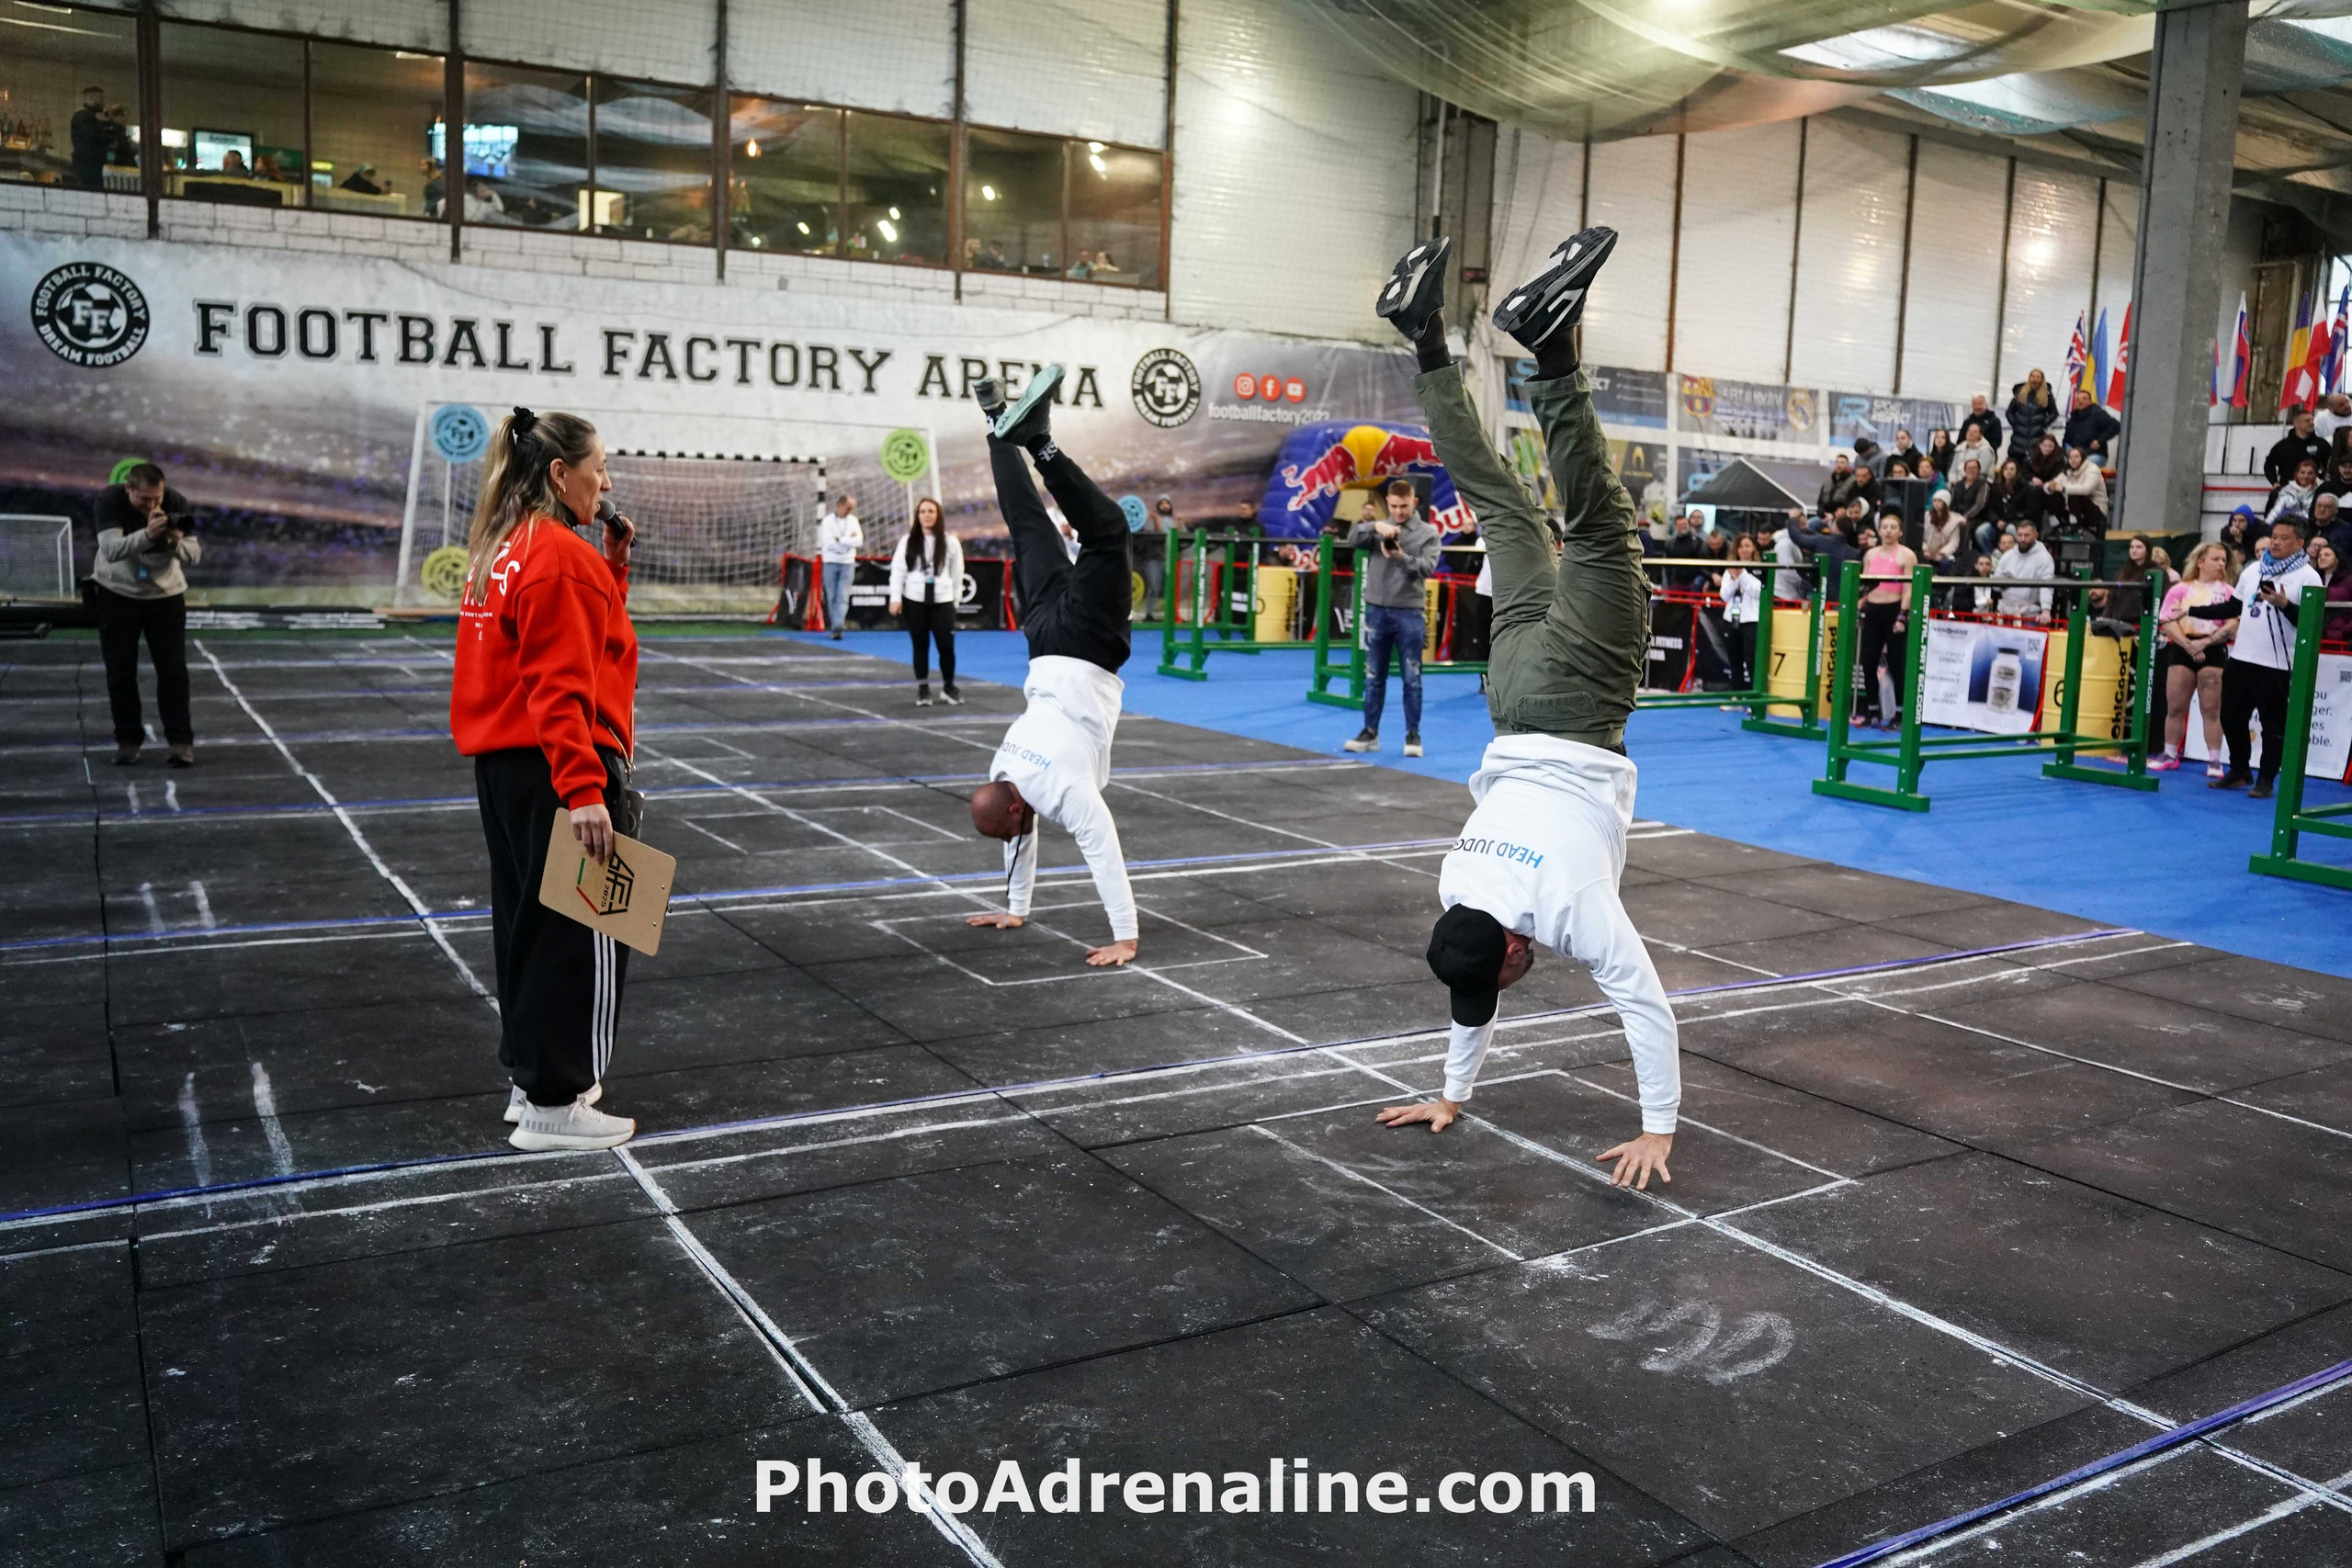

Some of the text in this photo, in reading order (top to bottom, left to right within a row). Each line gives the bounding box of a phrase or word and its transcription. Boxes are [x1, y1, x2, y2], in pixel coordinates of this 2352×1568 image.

[193, 299, 576, 375] FOOTBALL
[601, 328, 892, 395] FACTORY
[1774, 651, 1786, 676] 7
[1002, 741, 1052, 771] HEAD JUD
[1452, 838, 1544, 869] HEAD JUDG
